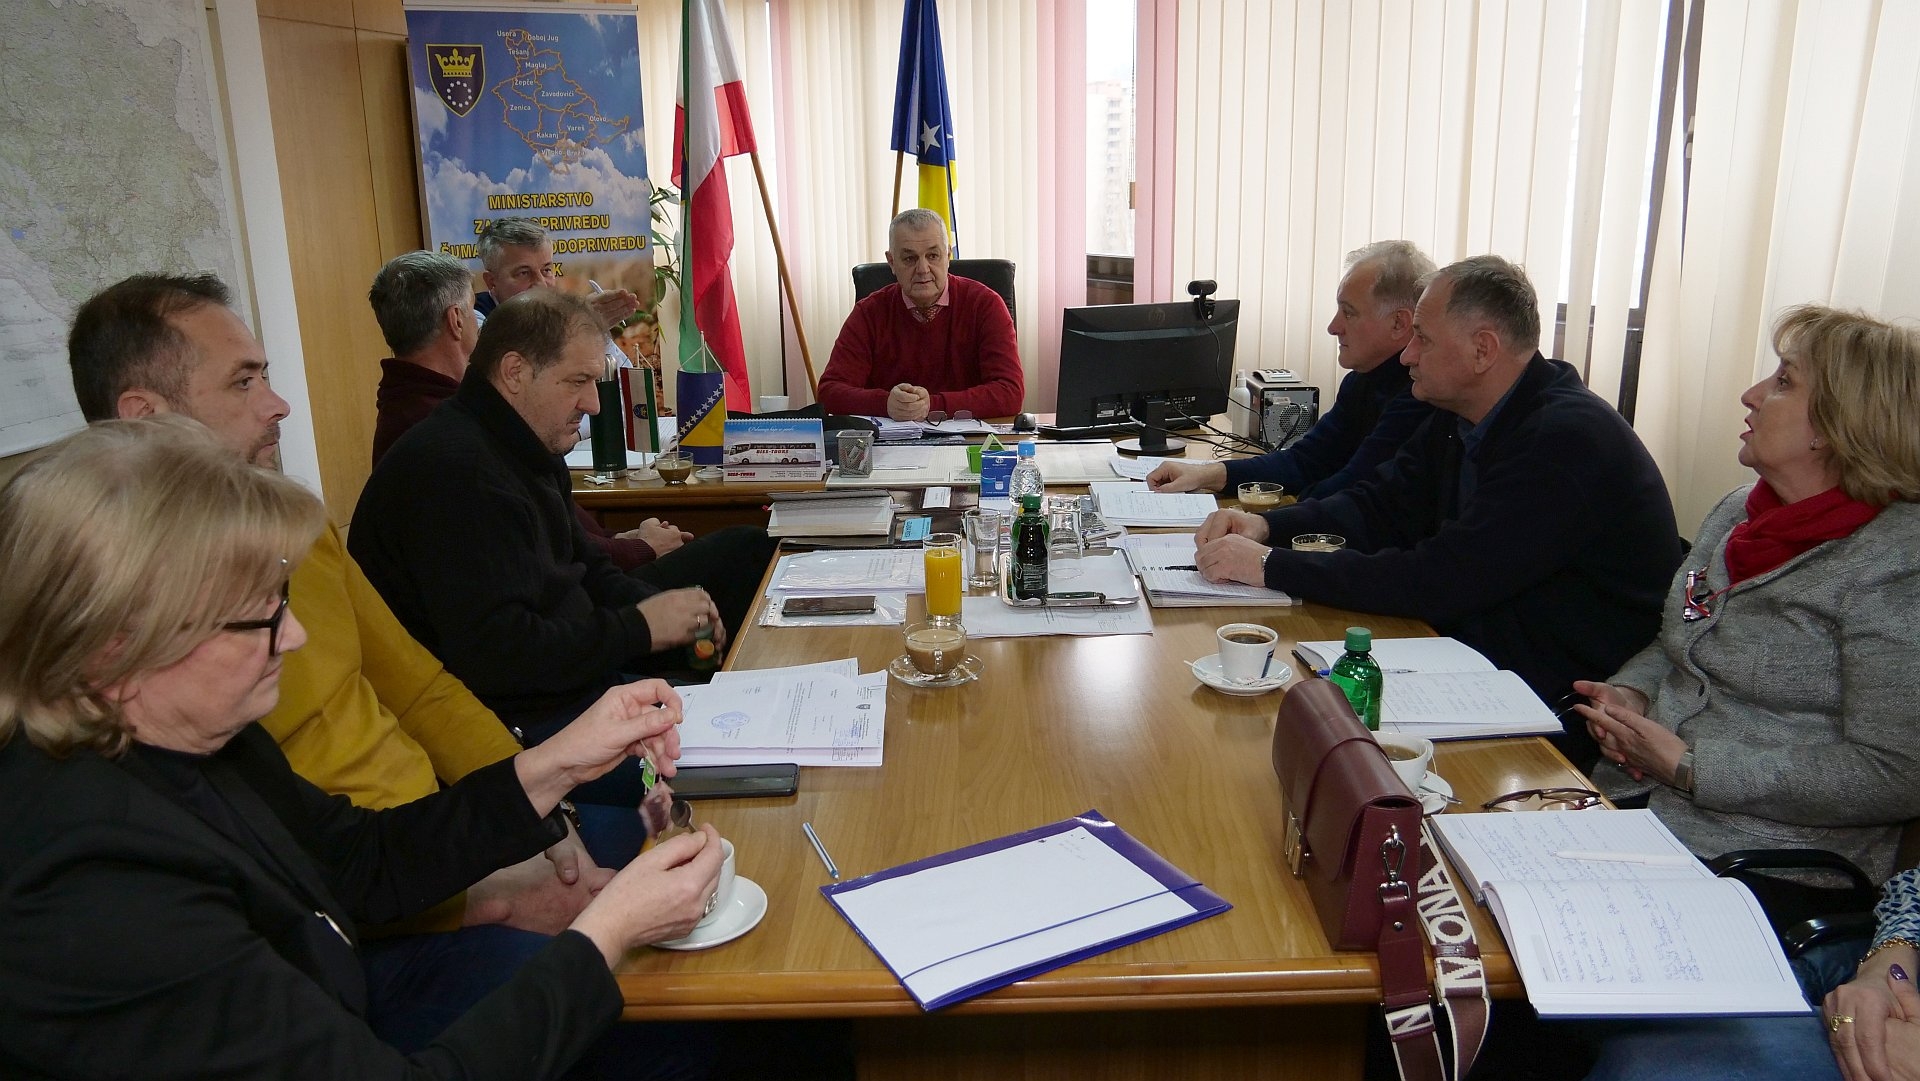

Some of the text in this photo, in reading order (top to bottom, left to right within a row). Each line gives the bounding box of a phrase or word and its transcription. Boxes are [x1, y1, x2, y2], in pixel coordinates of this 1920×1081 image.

[528, 34, 546, 42] Doboj
[525, 61, 547, 69] Maglaj
[536, 131, 559, 139] Kakanj
[488, 192, 593, 210] MINISTARSTVO
